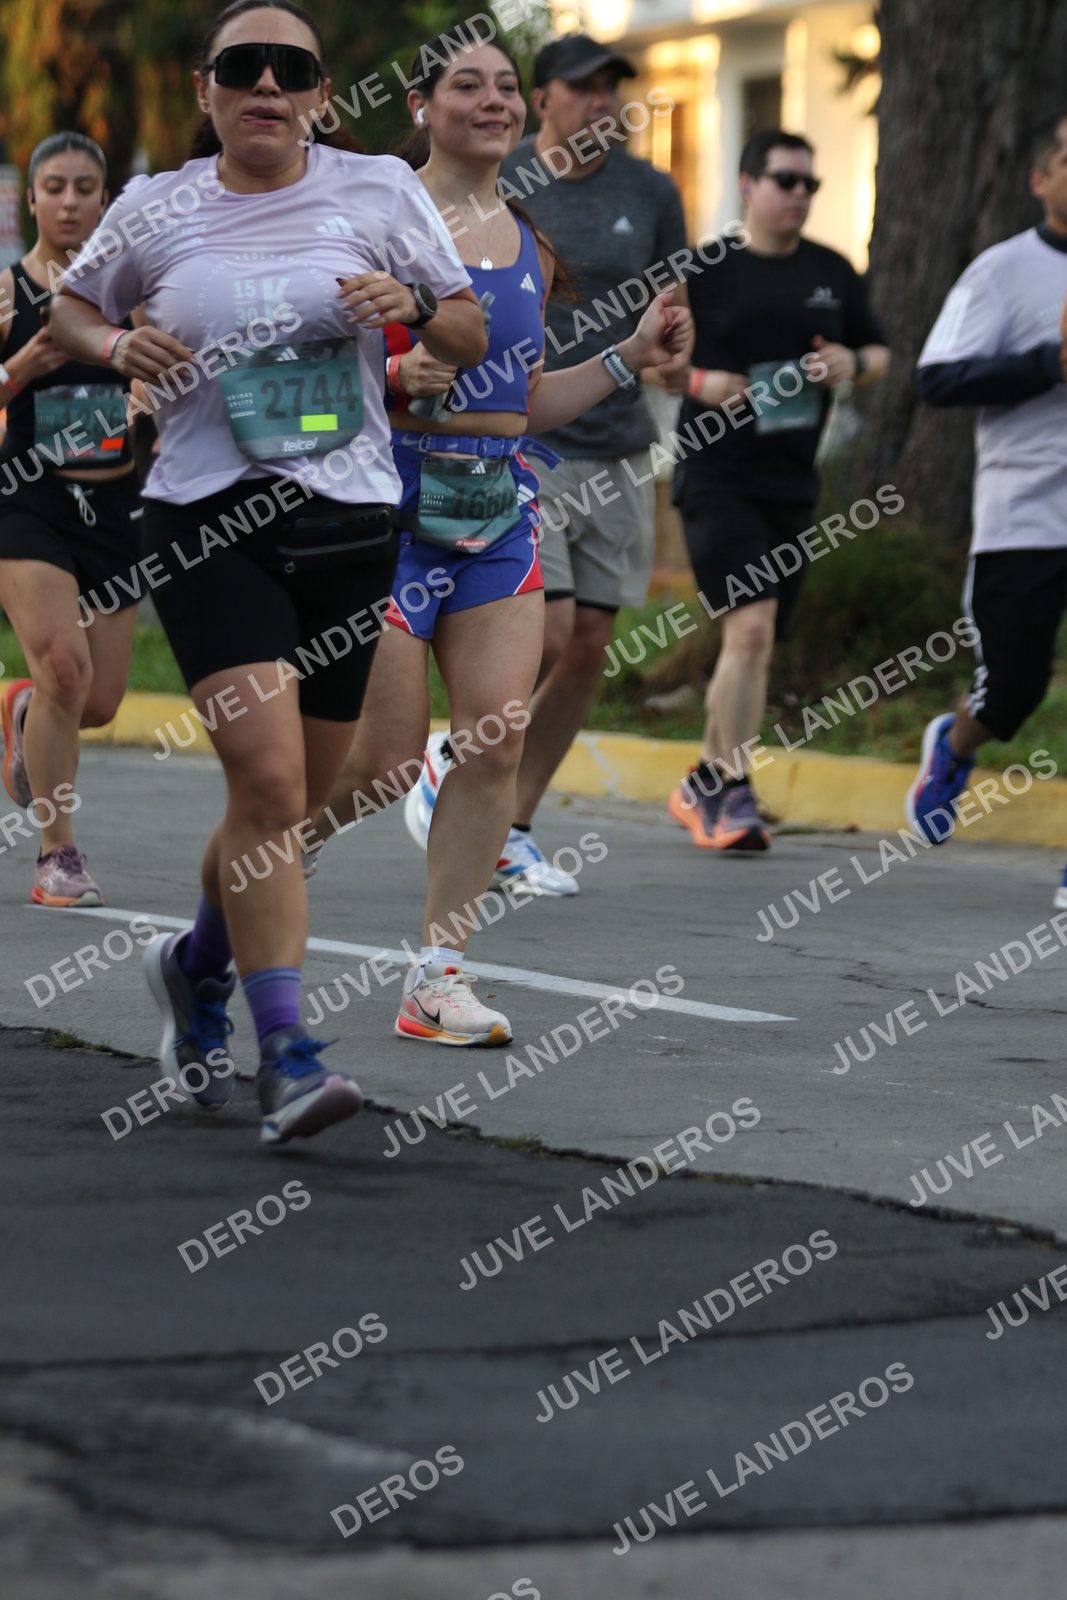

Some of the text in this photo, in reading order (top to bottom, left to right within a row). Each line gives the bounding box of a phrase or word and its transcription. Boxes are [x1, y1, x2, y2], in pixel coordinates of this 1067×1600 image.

[233, 280, 256, 298] 15
[262, 278, 291, 323] K
[235, 308, 259, 327] 30
[261, 371, 359, 419] 2744
[283, 437, 318, 452] telcel
